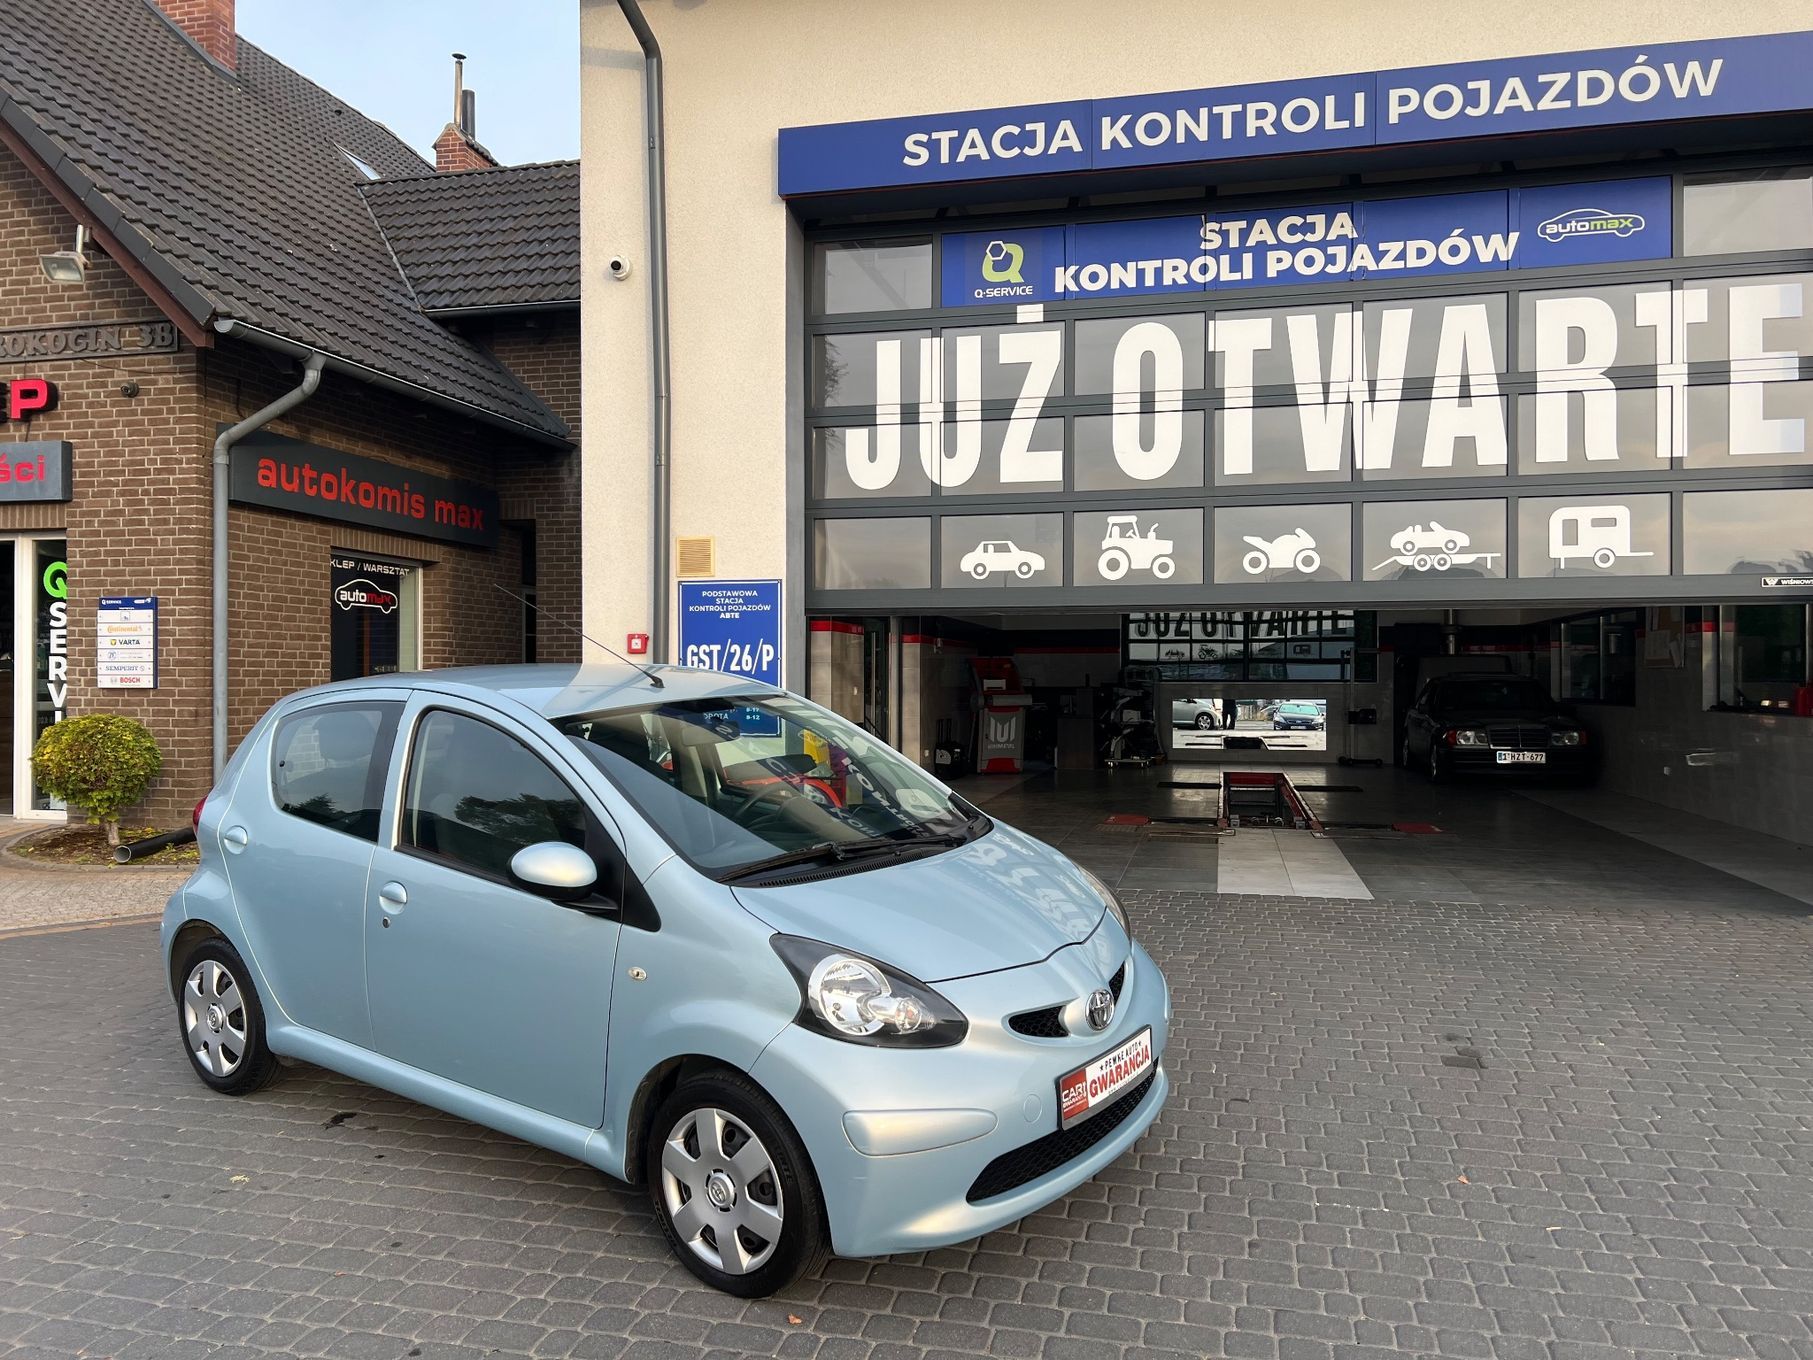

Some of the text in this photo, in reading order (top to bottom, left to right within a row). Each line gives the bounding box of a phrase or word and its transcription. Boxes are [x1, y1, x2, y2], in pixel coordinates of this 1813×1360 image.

[902, 54, 1724, 167] STACJA KONTROLI POJAZDÓW
[1200, 212, 1359, 250] STACJA
[1545, 217, 1635, 234] automax
[1054, 228, 1520, 293] KONTROLI POJAZDÓW
[138, 322, 173, 347] 3B
[845, 283, 1806, 490] JUŻ OTWARTE
[257, 457, 485, 530] autokomis max
[363, 563, 410, 576] WARSZTAT
[340, 589, 393, 605] automax
[687, 638, 774, 674] GST/26/P
[1089, 1044, 1150, 1098] GWARANCJA
